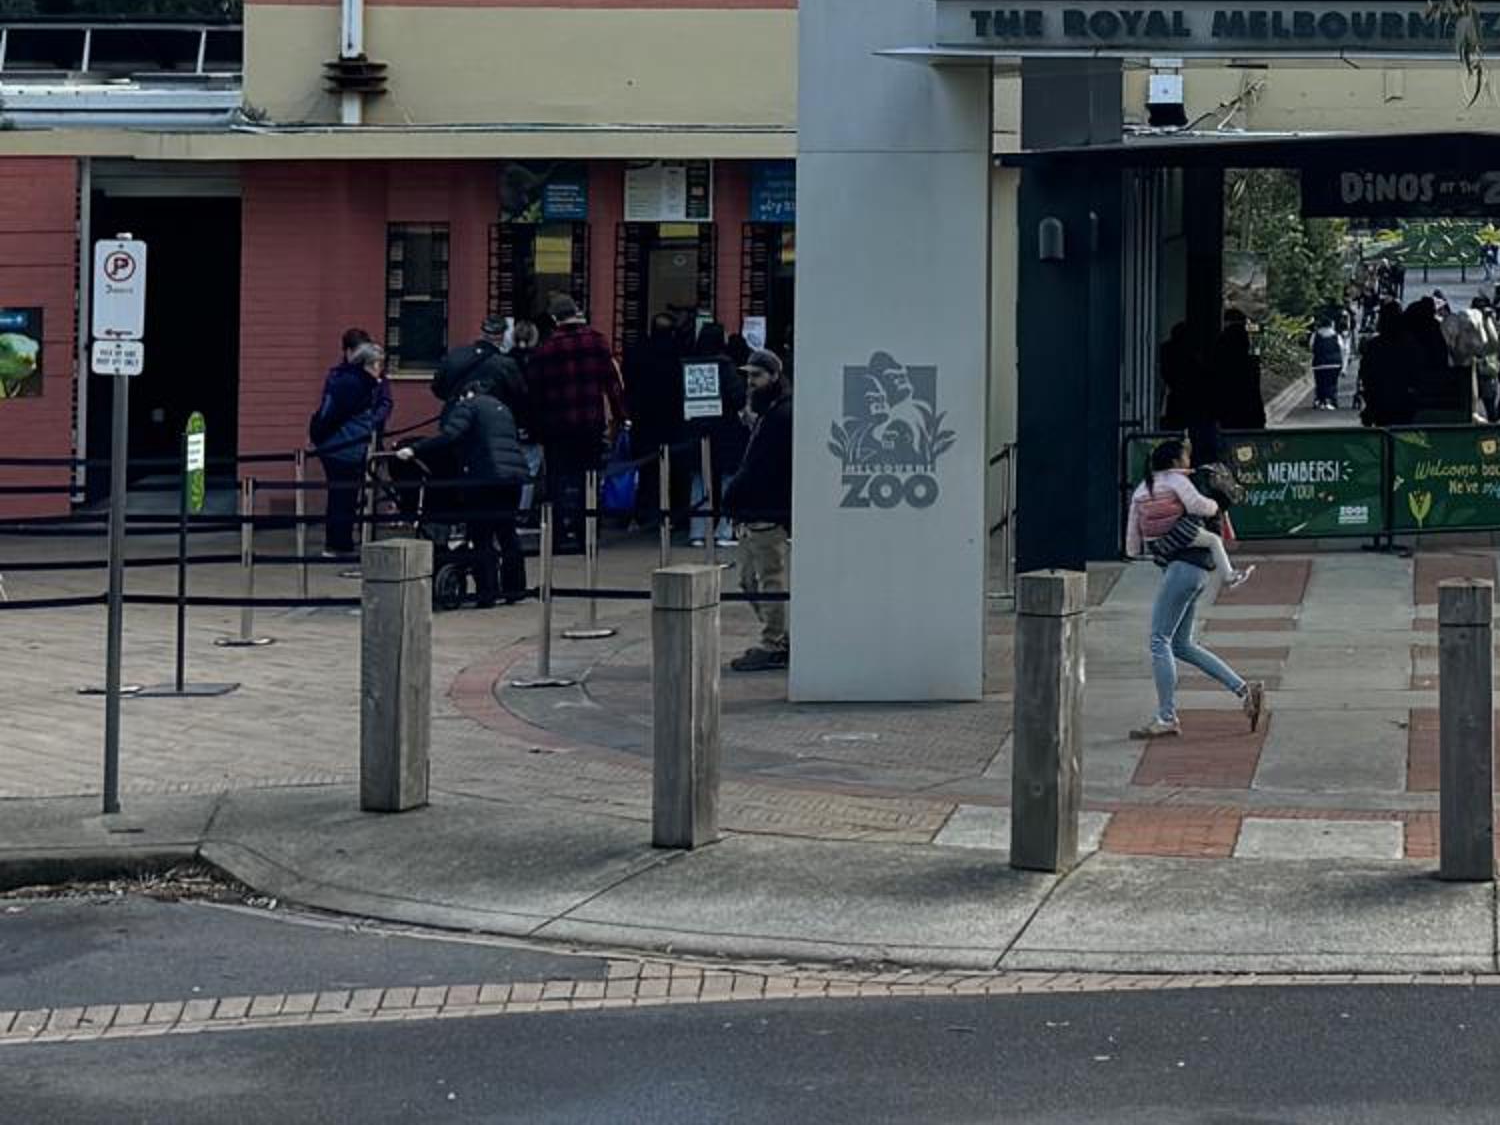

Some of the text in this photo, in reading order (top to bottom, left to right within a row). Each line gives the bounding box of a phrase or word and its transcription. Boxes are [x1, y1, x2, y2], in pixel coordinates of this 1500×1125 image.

[970, 9, 1043, 38] THE
[1062, 9, 1192, 40] ROYAL
[1211, 9, 1457, 40] MELBOURNE
[1266, 459, 1340, 484] MEMBERS!
[1413, 458, 1478, 480] Welcome
[839, 474, 940, 509] ZOO
[1448, 478, 1480, 496] We've
